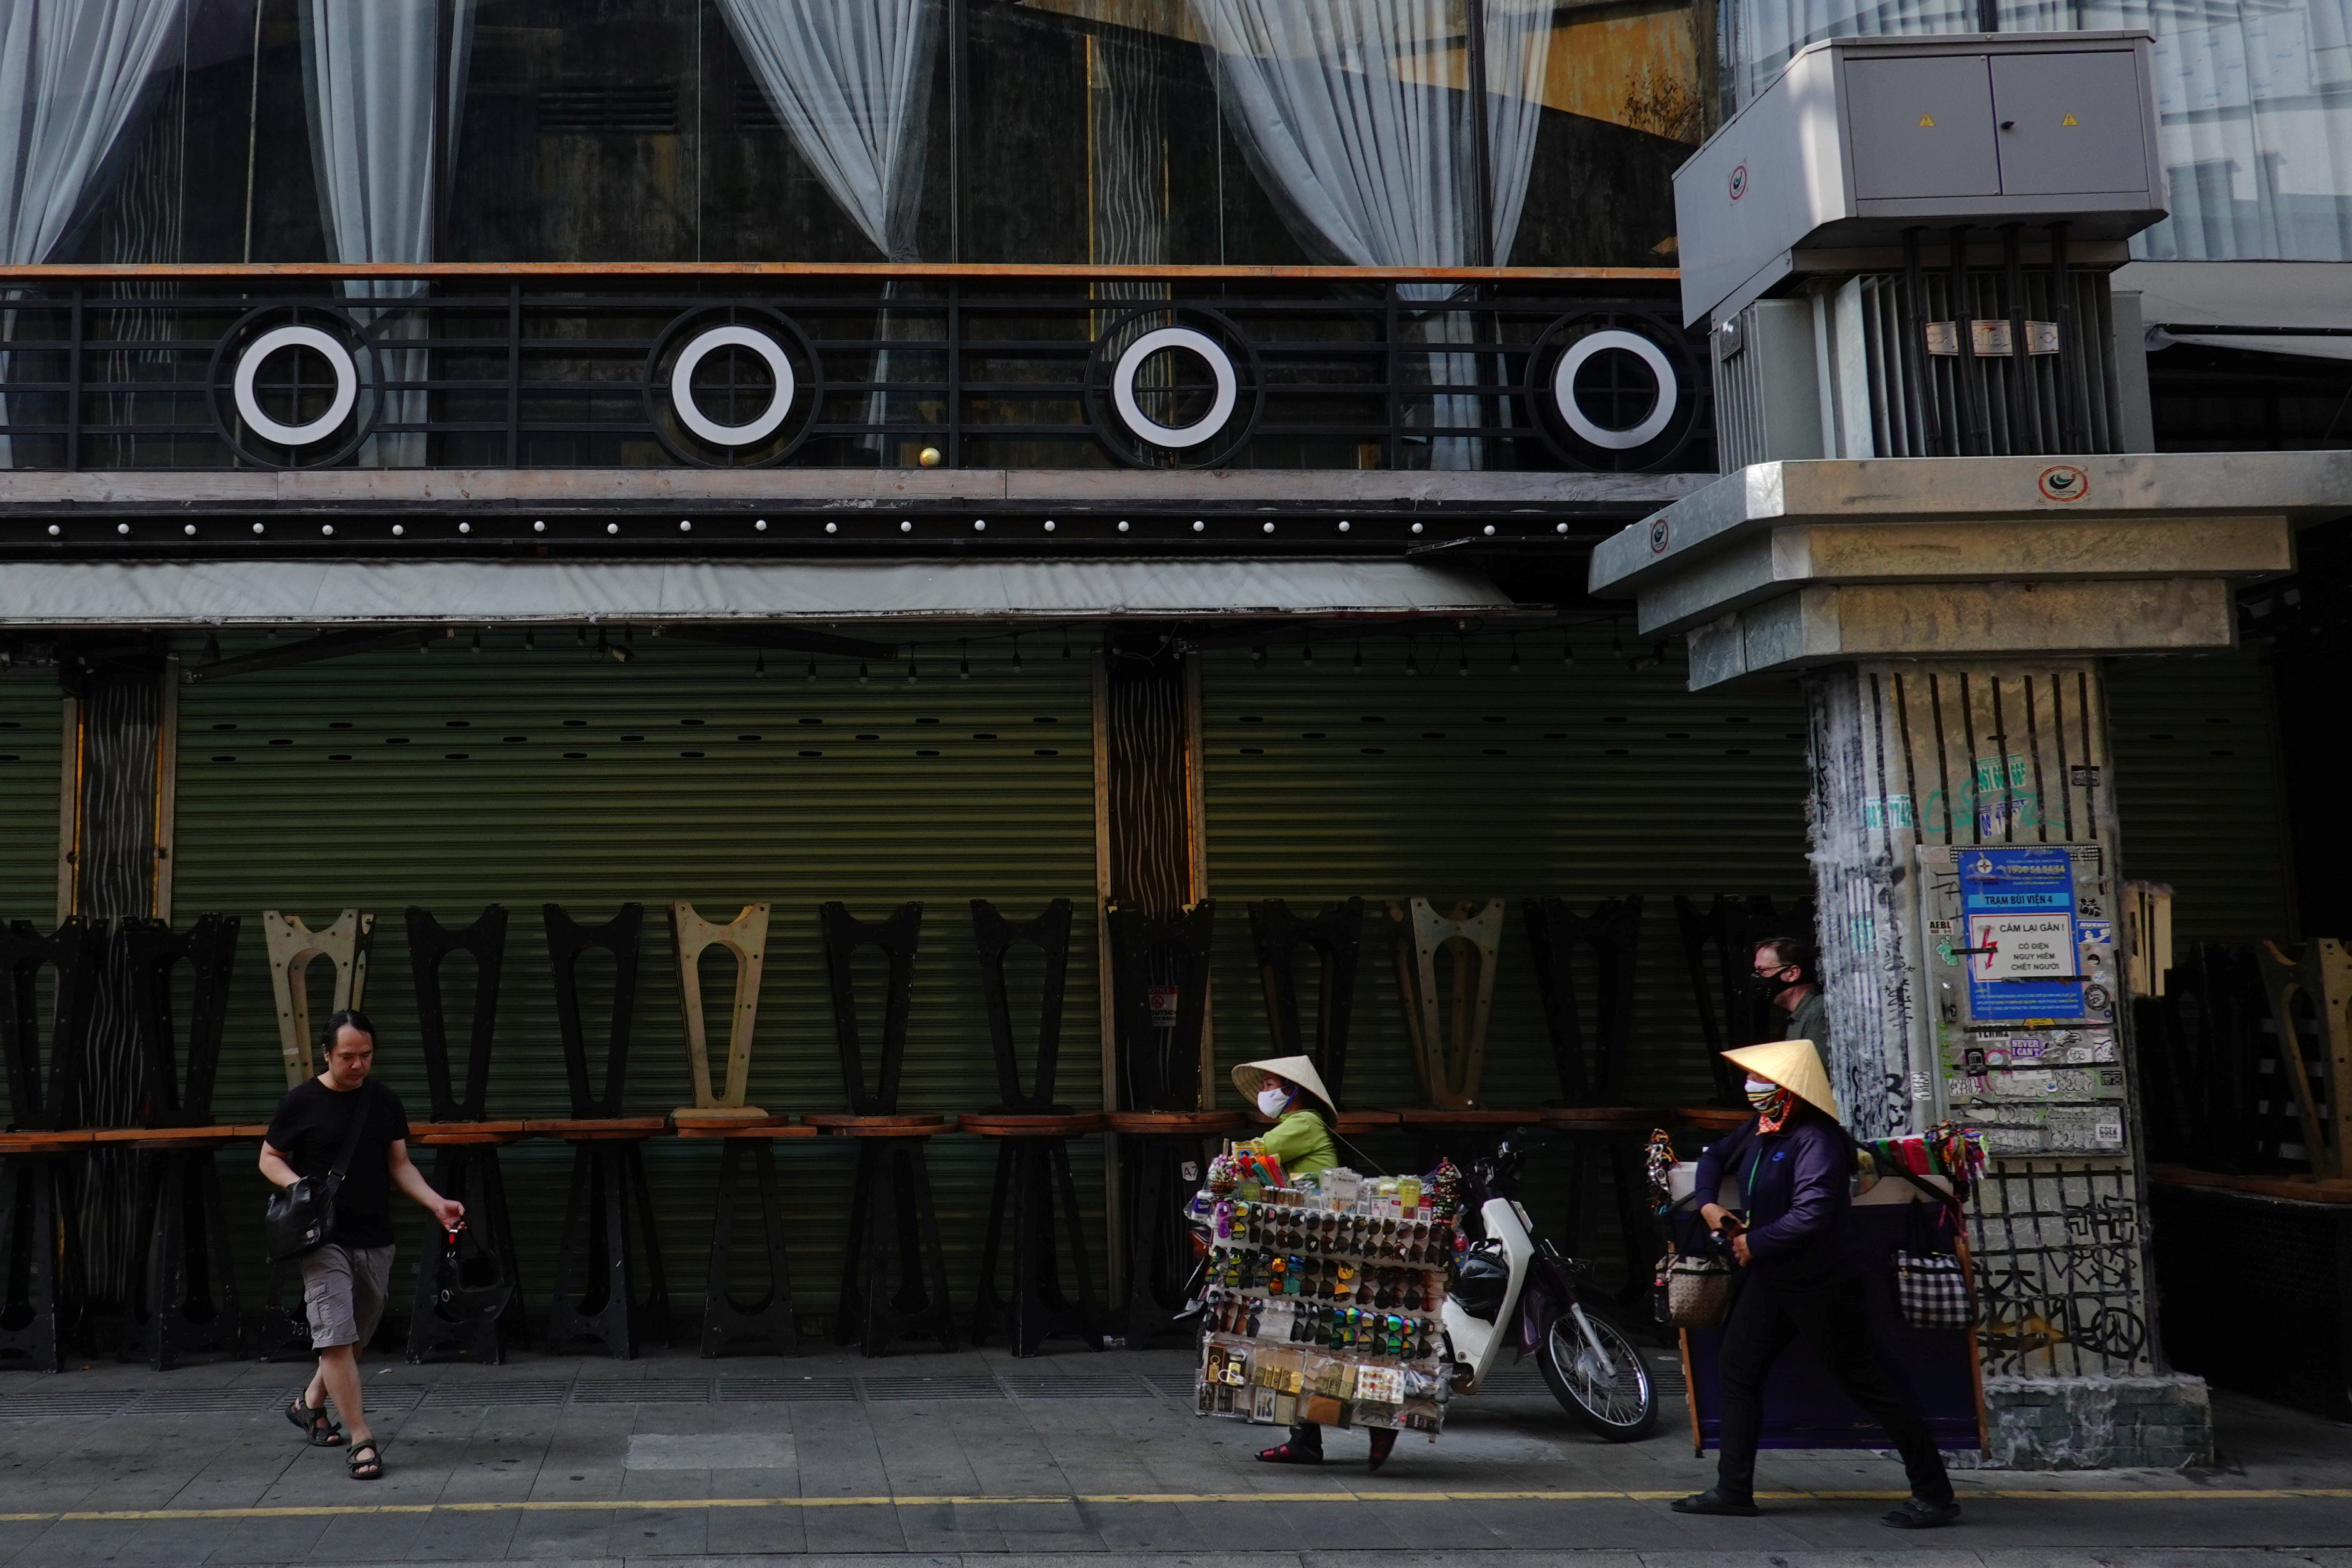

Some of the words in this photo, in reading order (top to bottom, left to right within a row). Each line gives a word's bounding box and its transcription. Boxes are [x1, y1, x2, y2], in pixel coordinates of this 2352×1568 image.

[2011, 894, 2024, 904] BÙI
[2048, 896, 2053, 904] 4
[2023, 924, 2037, 933] LẠI
[2012, 1039, 2038, 1047] NEVER
